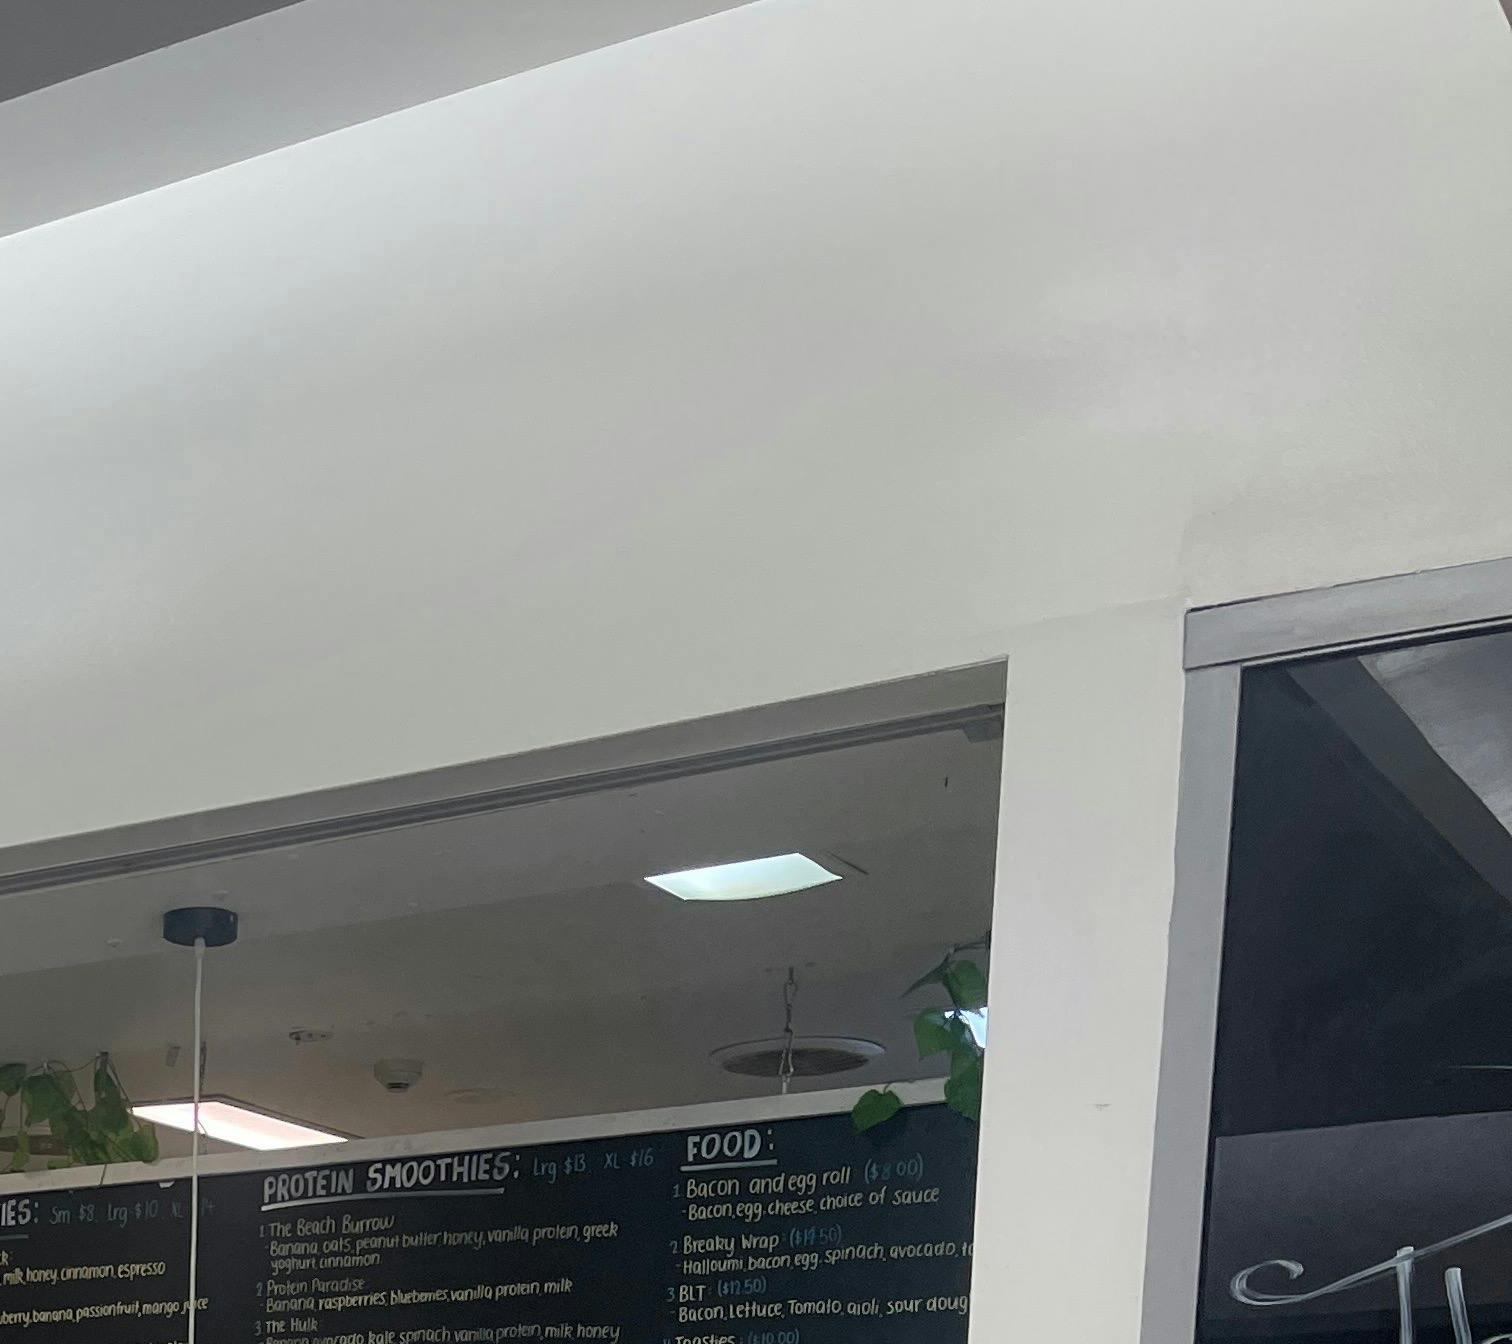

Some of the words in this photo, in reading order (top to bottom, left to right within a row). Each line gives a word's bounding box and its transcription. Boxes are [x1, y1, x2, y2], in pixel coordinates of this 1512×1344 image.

[686, 1128, 775, 1162] FOOD:
[263, 1168, 354, 1203] PROTEIN
[366, 1151, 520, 1193] SMOOTHIES:
[533, 1159, 557, 1184] Lrg
[604, 1152, 621, 1170] XL
[629, 1147, 654, 1168] $16
[686, 1179, 739, 1199] Bacon
[749, 1174, 785, 1194] and
[787, 1172, 816, 1195] egg
[822, 1166, 851, 1186] roll
[819, 1190, 863, 1211] choice
[869, 1186, 887, 1204] of
[892, 1186, 940, 1206] sauce
[50, 1205, 70, 1225] Sm
[269, 1222, 292, 1238] The
[297, 1216, 336, 1237] Beach
[342, 1214, 395, 1234] Burrow
[355, 1234, 399, 1255] peanut
[488, 1225, 528, 1241] vanilla
[583, 1221, 618, 1243] greek
[683, 1235, 735, 1256] Breaky
[117, 1261, 166, 1281] espresso
[544, 1278, 573, 1294] milk
[679, 1285, 706, 1302] BLT
[142, 1300, 180, 1318] mango
[887, 1297, 920, 1314] sour
[926, 1295, 968, 1315] doug
[290, 1317, 319, 1333] Hulk
[454, 1326, 494, 1343] vanilla
[576, 1322, 621, 1344] honey
